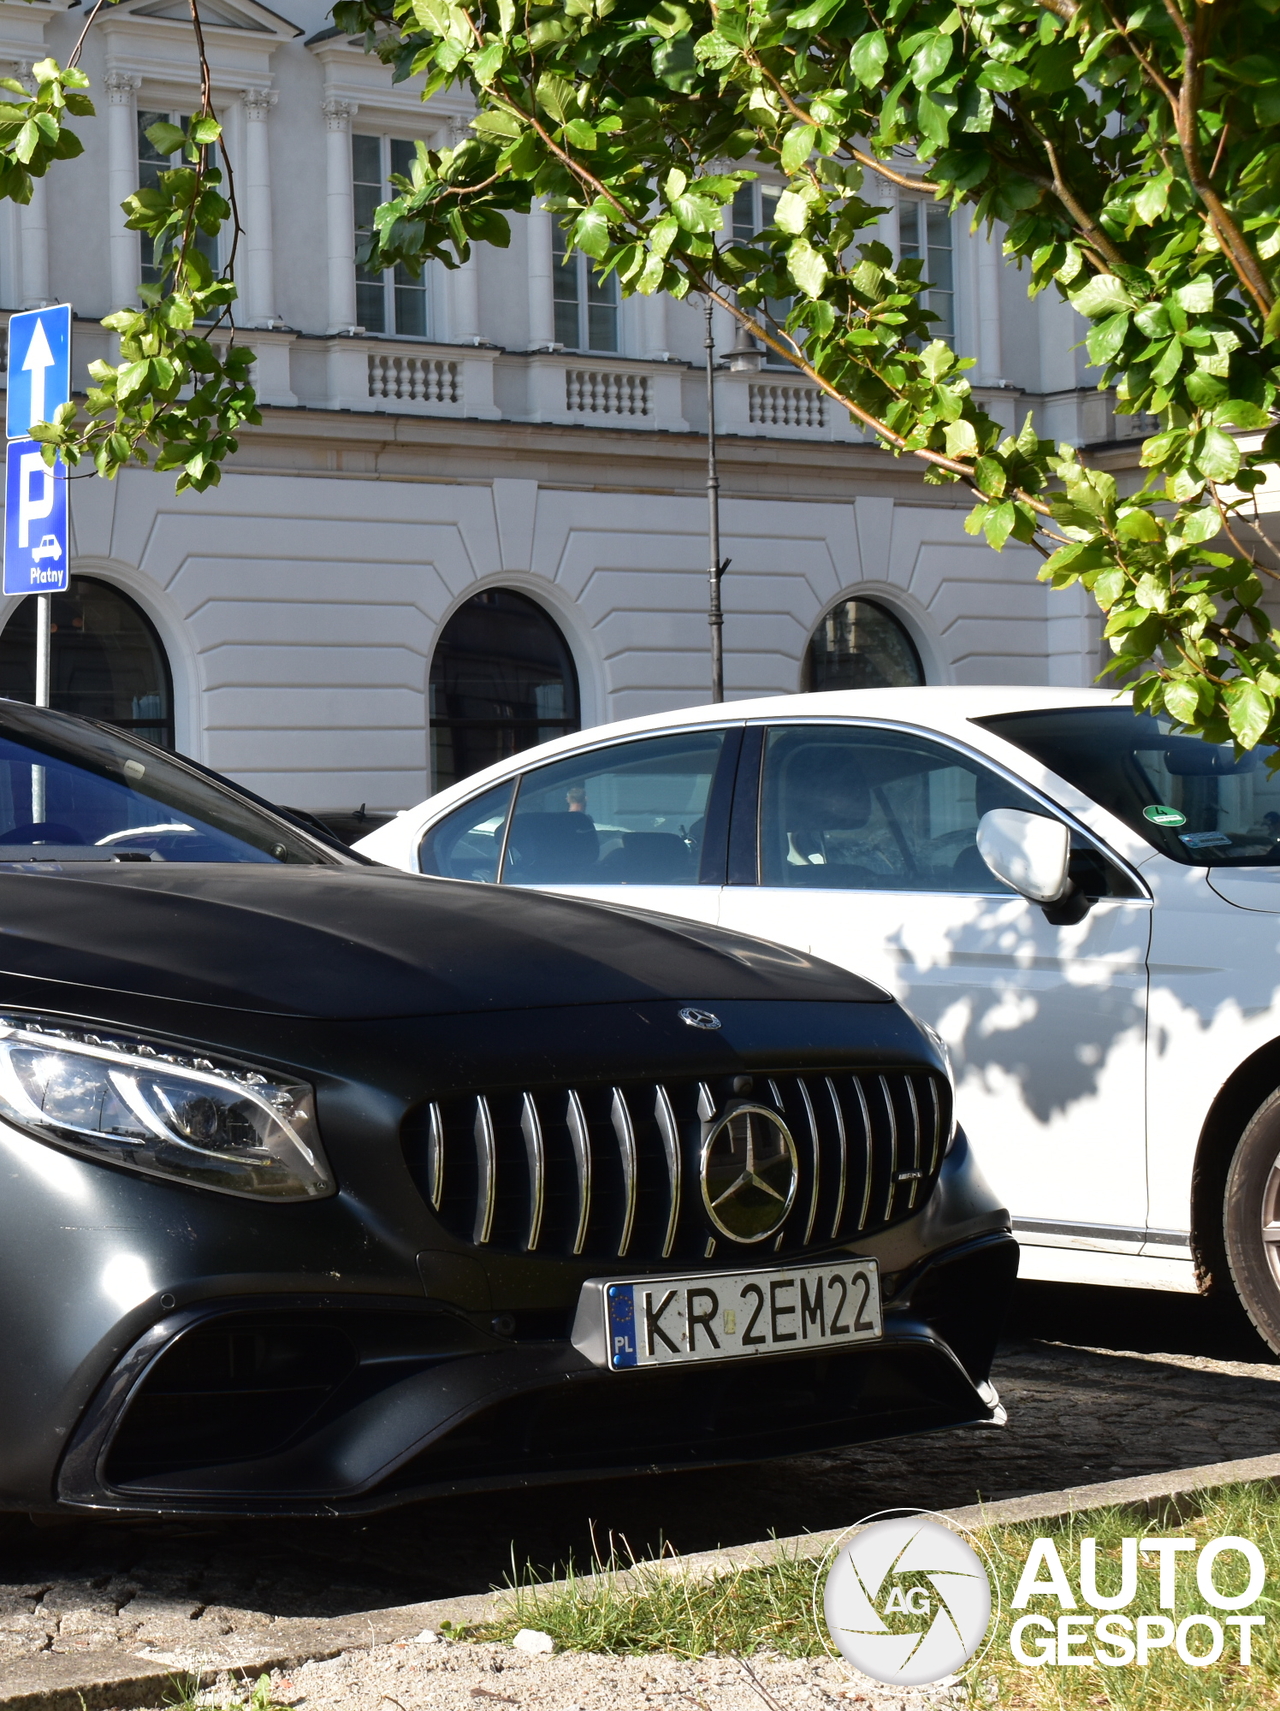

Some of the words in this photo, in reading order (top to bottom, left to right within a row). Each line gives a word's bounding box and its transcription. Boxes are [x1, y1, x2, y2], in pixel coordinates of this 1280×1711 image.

[19, 452, 55, 548] P
[30, 567, 64, 587] Płatny
[1155, 807, 1167, 815] 4
[642, 1288, 721, 1357] KR
[739, 1270, 874, 1347] 2EM22
[614, 1336, 633, 1353] PL
